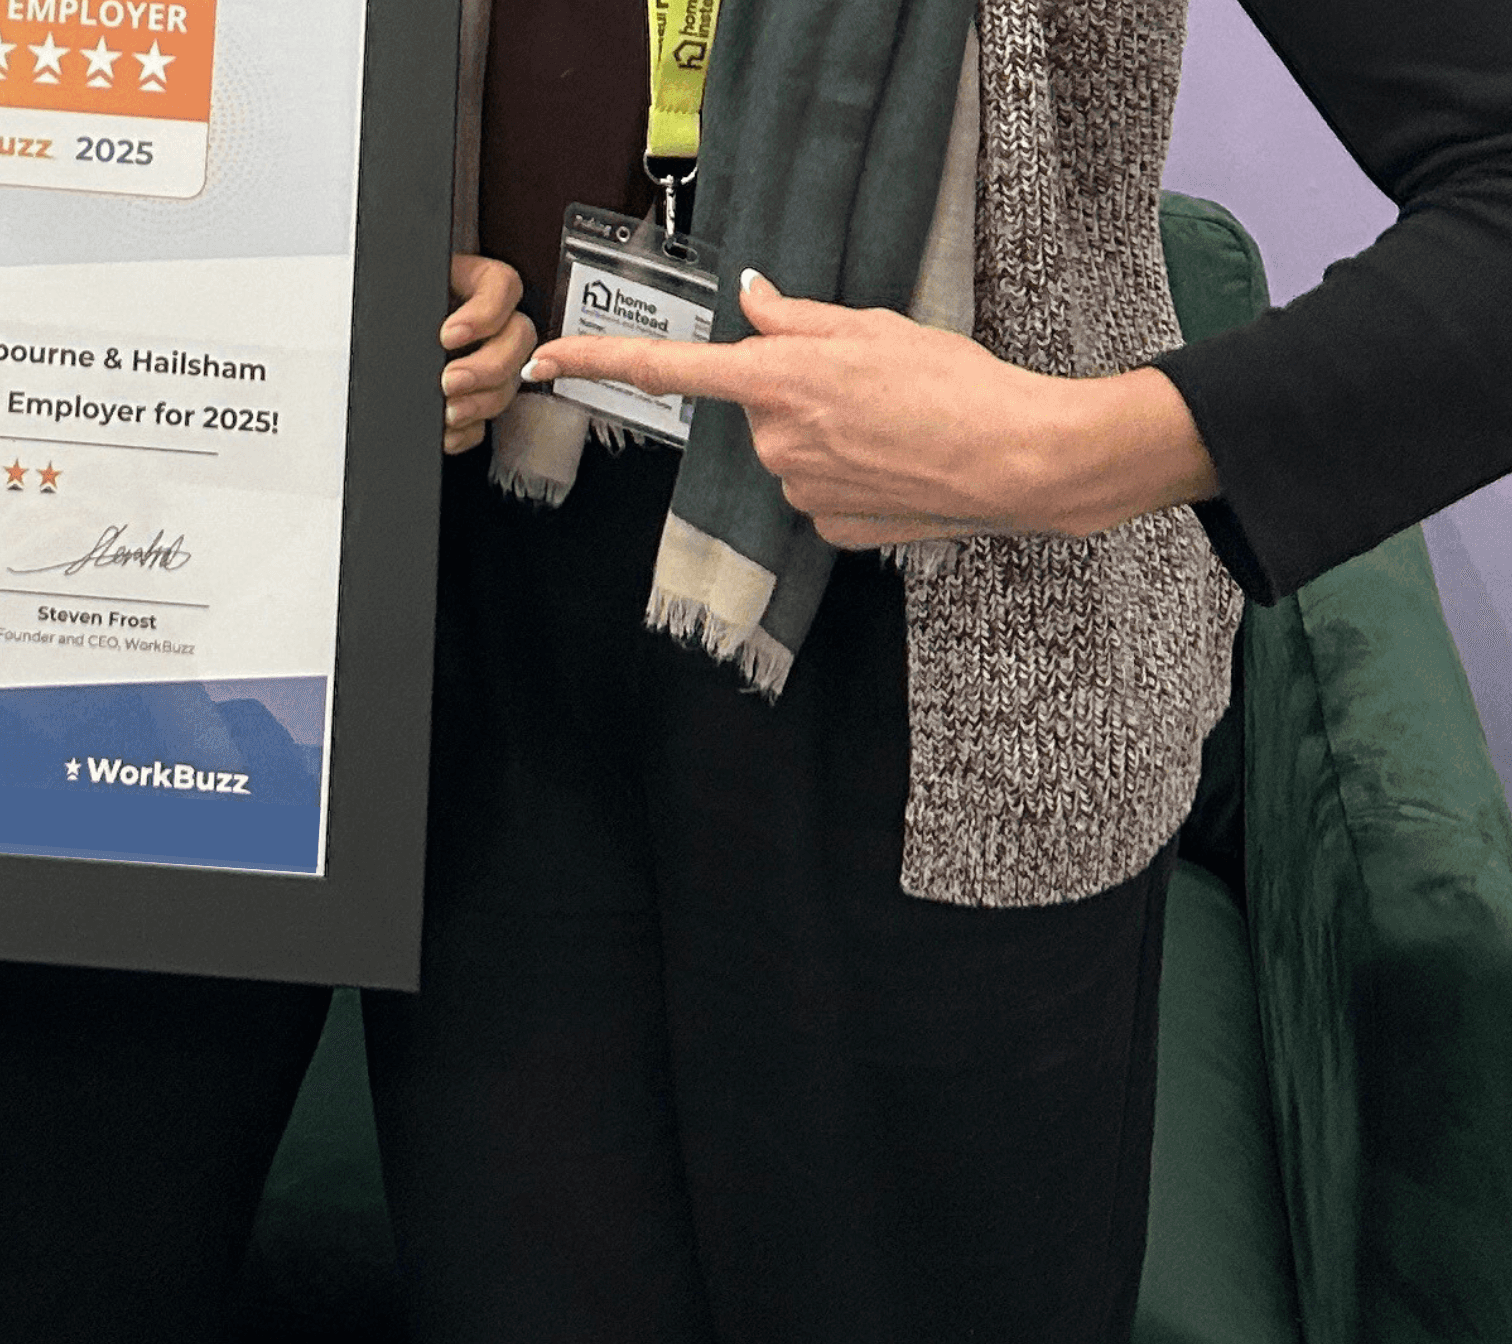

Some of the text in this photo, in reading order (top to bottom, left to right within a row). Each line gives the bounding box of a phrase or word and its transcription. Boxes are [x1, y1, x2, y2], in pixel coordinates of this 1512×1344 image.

[75, 136, 155, 166] 2025
[103, 347, 123, 370] &
[132, 349, 267, 382] Hailsham
[7, 390, 146, 427] Employer
[154, 400, 195, 428] for
[202, 406, 279, 434] 2025!
[37, 605, 157, 630] Steven Frost
[58, 632, 85, 647] and
[87, 633, 121, 650] CEO,
[125, 637, 196, 655] WorkBuzz
[87, 756, 252, 795] WorkBuzz
